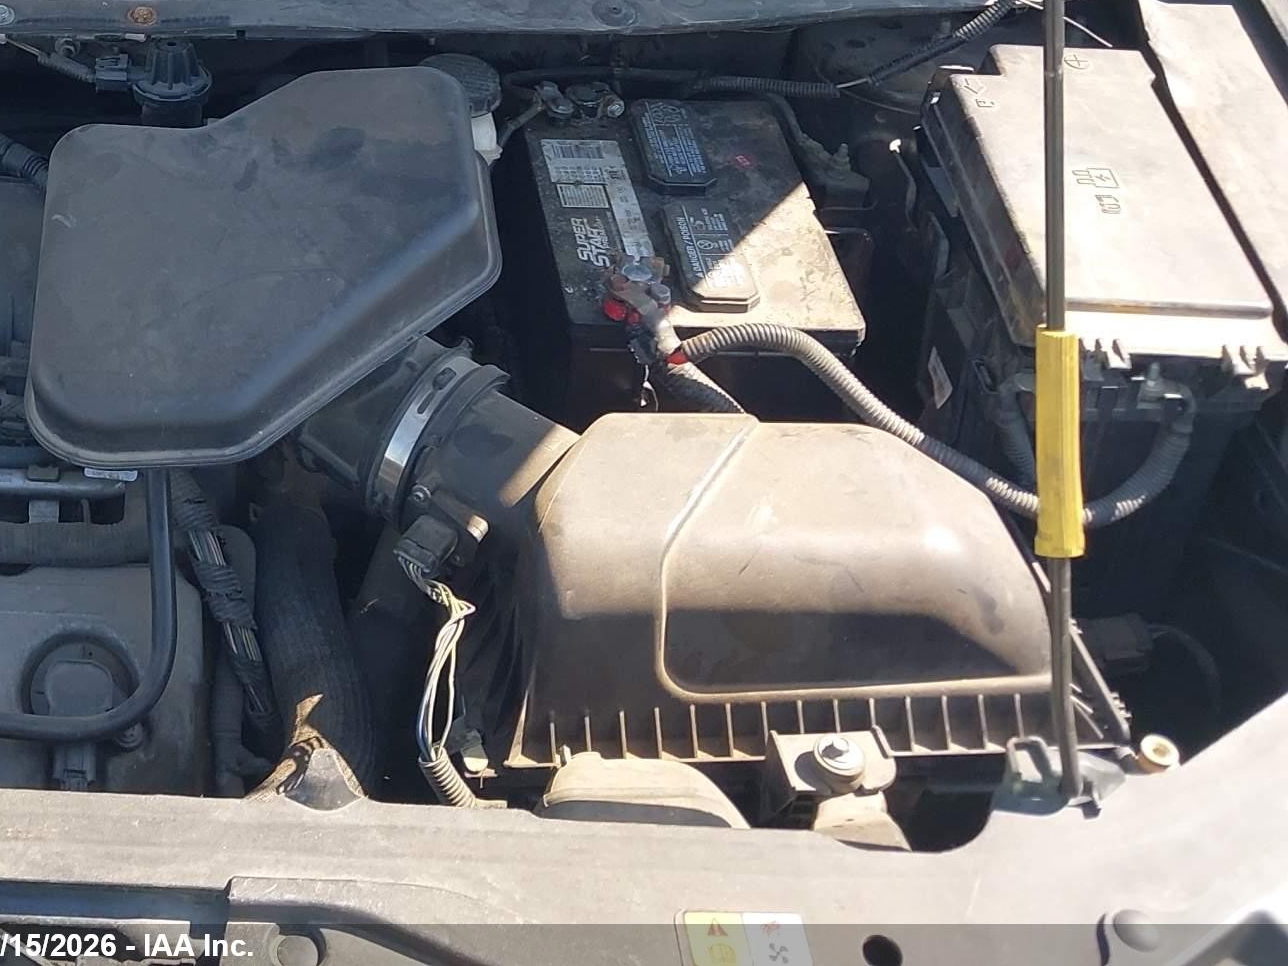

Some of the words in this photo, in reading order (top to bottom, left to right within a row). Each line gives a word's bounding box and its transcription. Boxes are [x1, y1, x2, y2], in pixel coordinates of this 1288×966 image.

[570, 217, 593, 262] SUPER
[675, 216, 692, 240] POISON
[685, 245, 702, 274] DANGER
